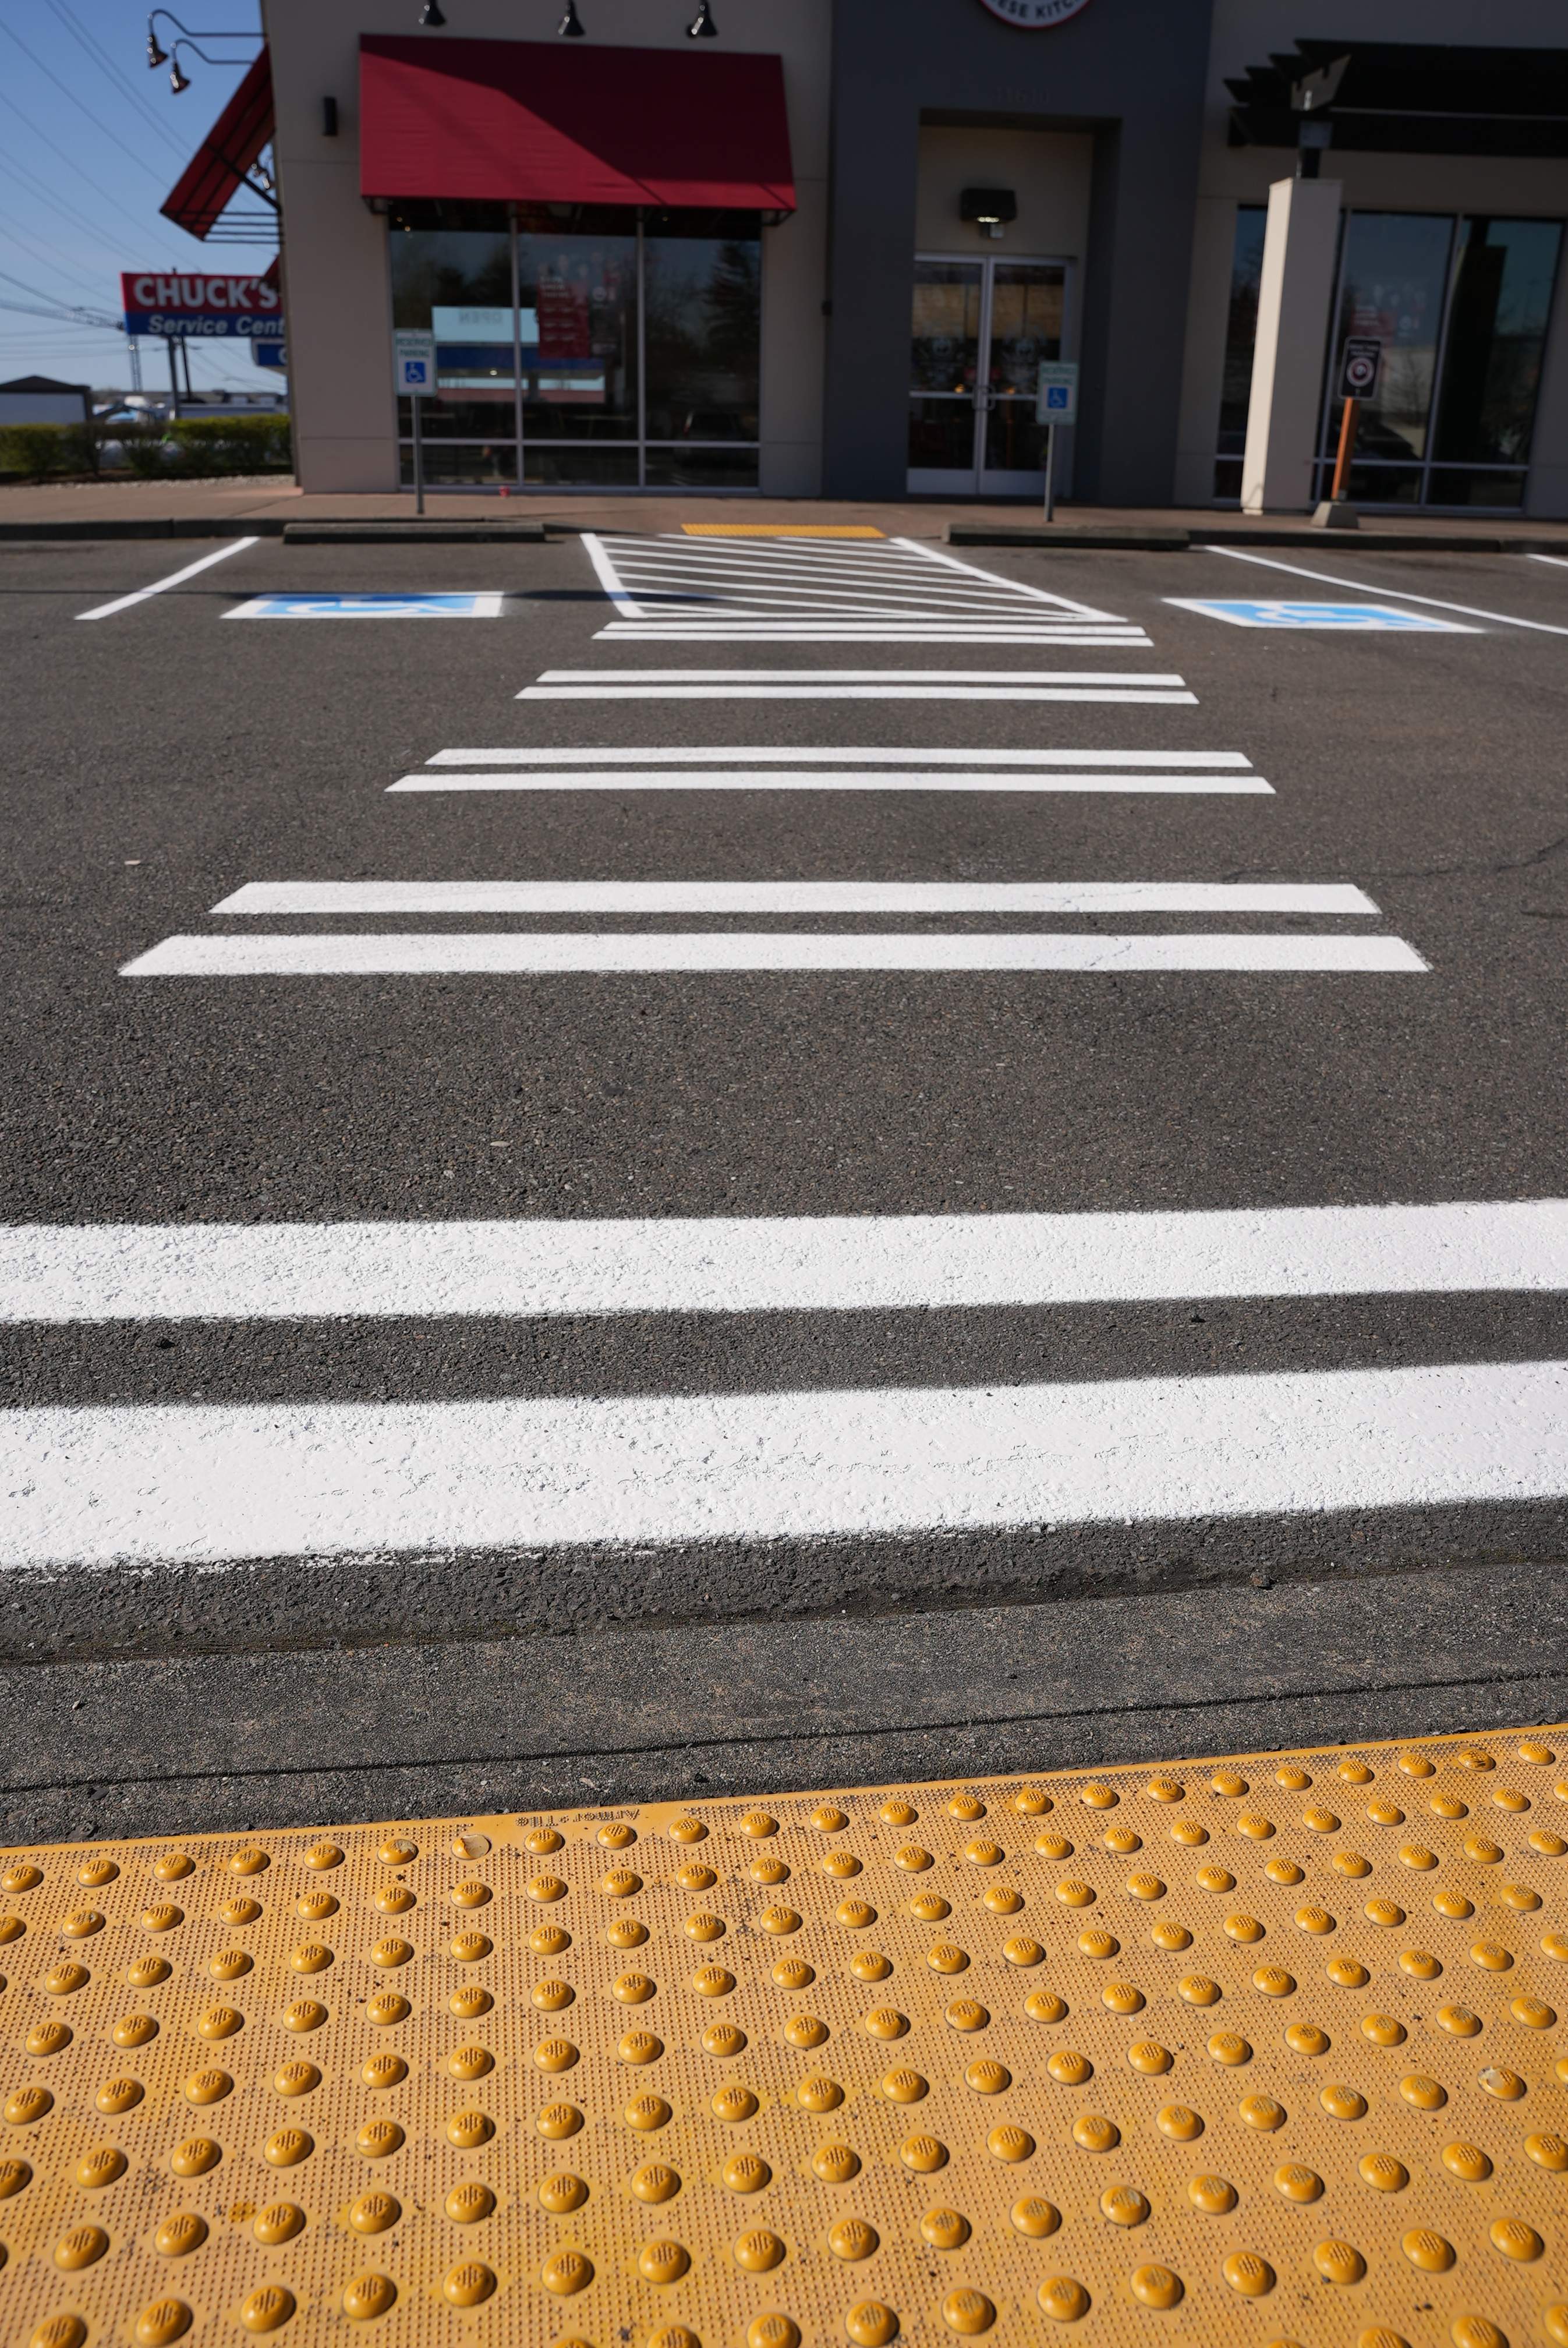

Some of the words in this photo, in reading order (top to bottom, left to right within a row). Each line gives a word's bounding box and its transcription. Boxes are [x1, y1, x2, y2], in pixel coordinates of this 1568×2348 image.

[993, 0, 1029, 19] ESE
[1035, 0, 1077, 19] KITC
[133, 276, 278, 308] CHUCK'S
[148, 314, 228, 334] Service
